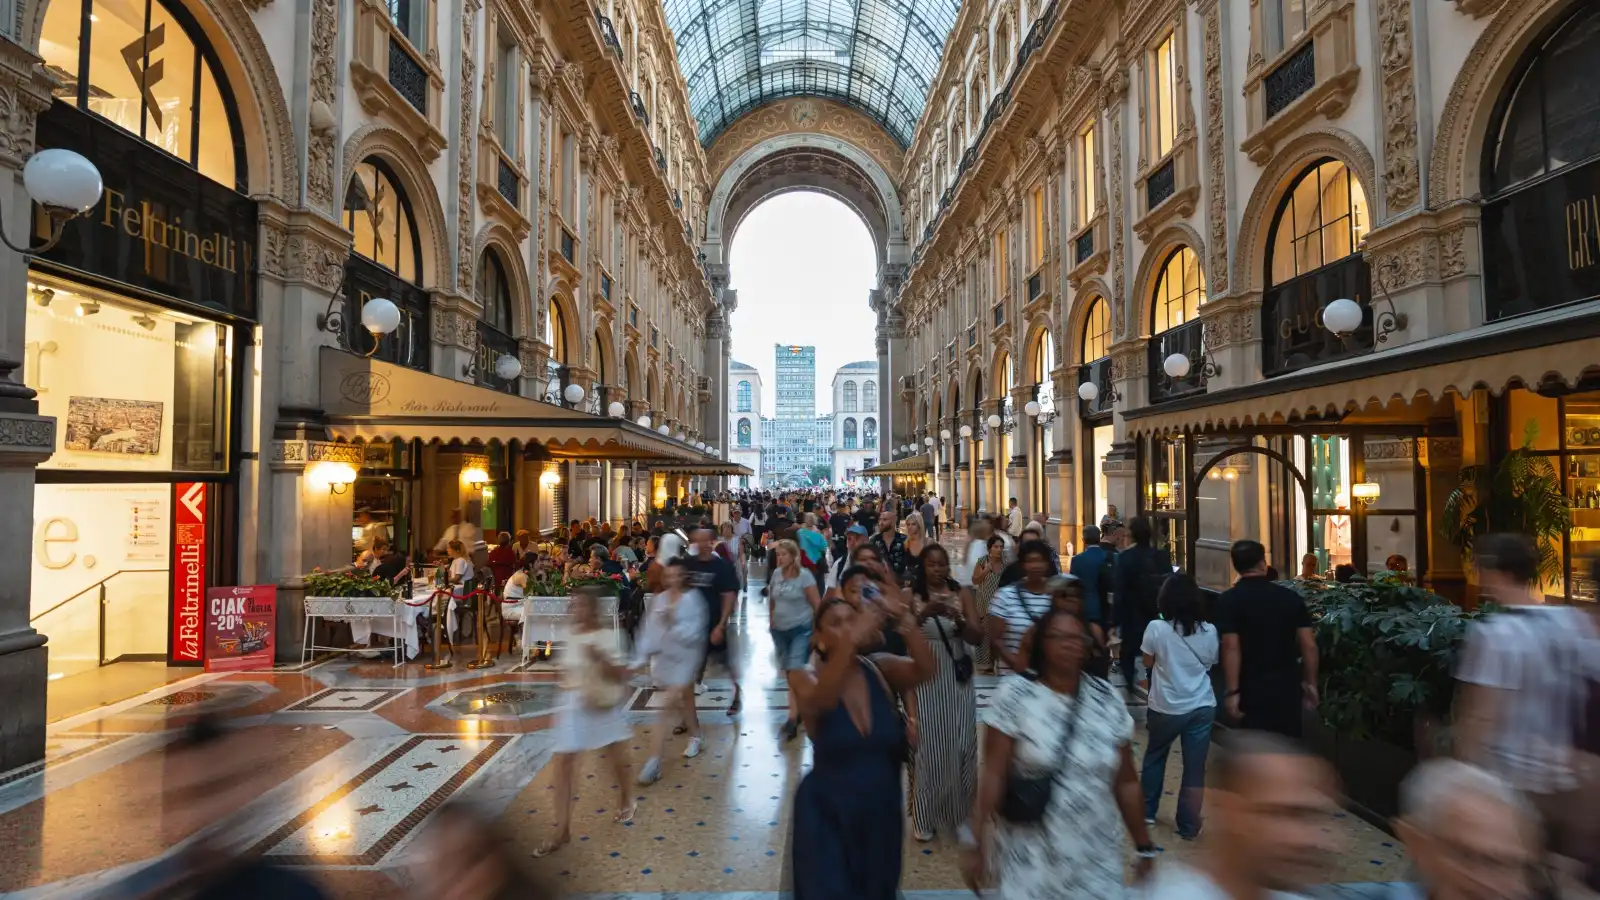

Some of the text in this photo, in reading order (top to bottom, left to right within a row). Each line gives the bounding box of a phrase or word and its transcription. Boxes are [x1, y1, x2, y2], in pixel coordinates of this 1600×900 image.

[101, 187, 237, 274] Feltrinelli
[343, 375, 383, 400] Biffi
[400, 399, 501, 412] Bar Ristorante
[180, 544, 200, 659] laFeltrinelli
[211, 597, 246, 616] CIAK
[210, 615, 243, 631] -20%
